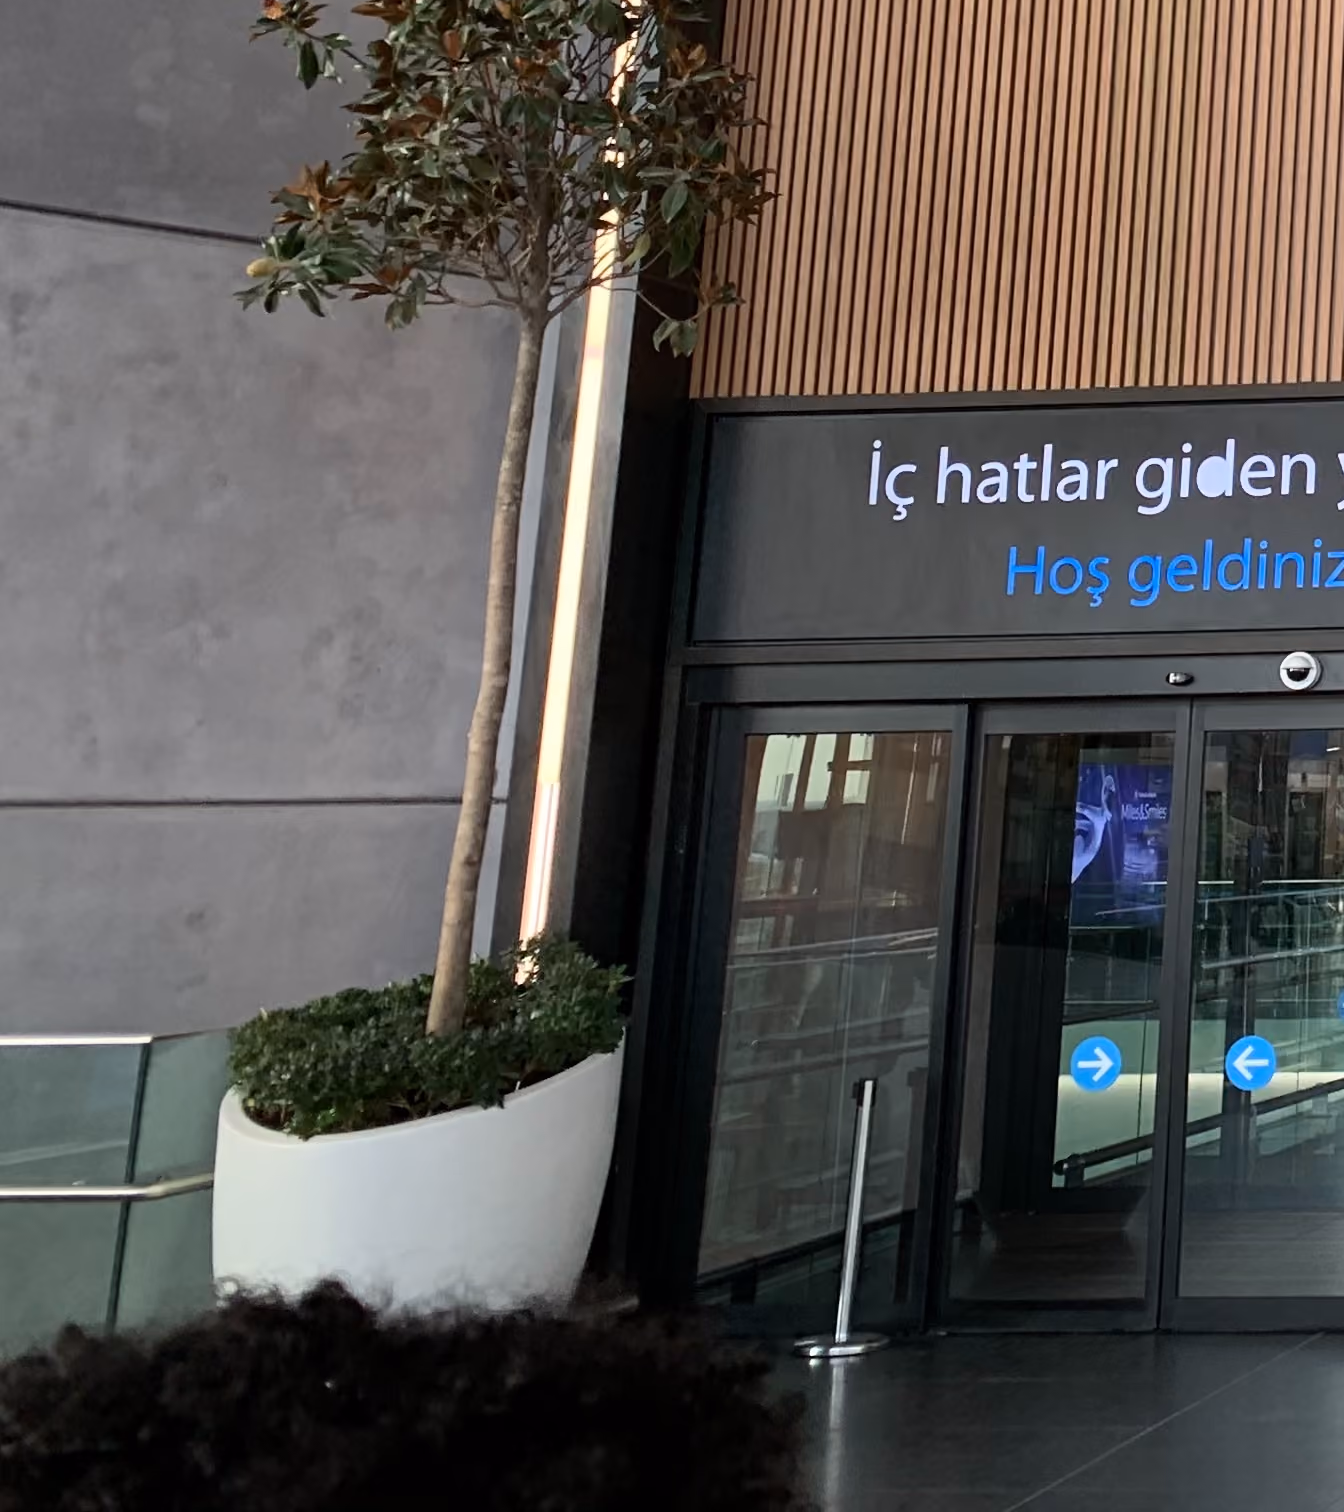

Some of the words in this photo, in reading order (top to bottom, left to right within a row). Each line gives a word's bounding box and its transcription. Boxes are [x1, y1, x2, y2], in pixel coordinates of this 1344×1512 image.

[867, 438, 918, 522] İç
[935, 442, 1119, 505] hatlar
[1134, 437, 1317, 515] giden
[1005, 543, 1112, 608] Hoş
